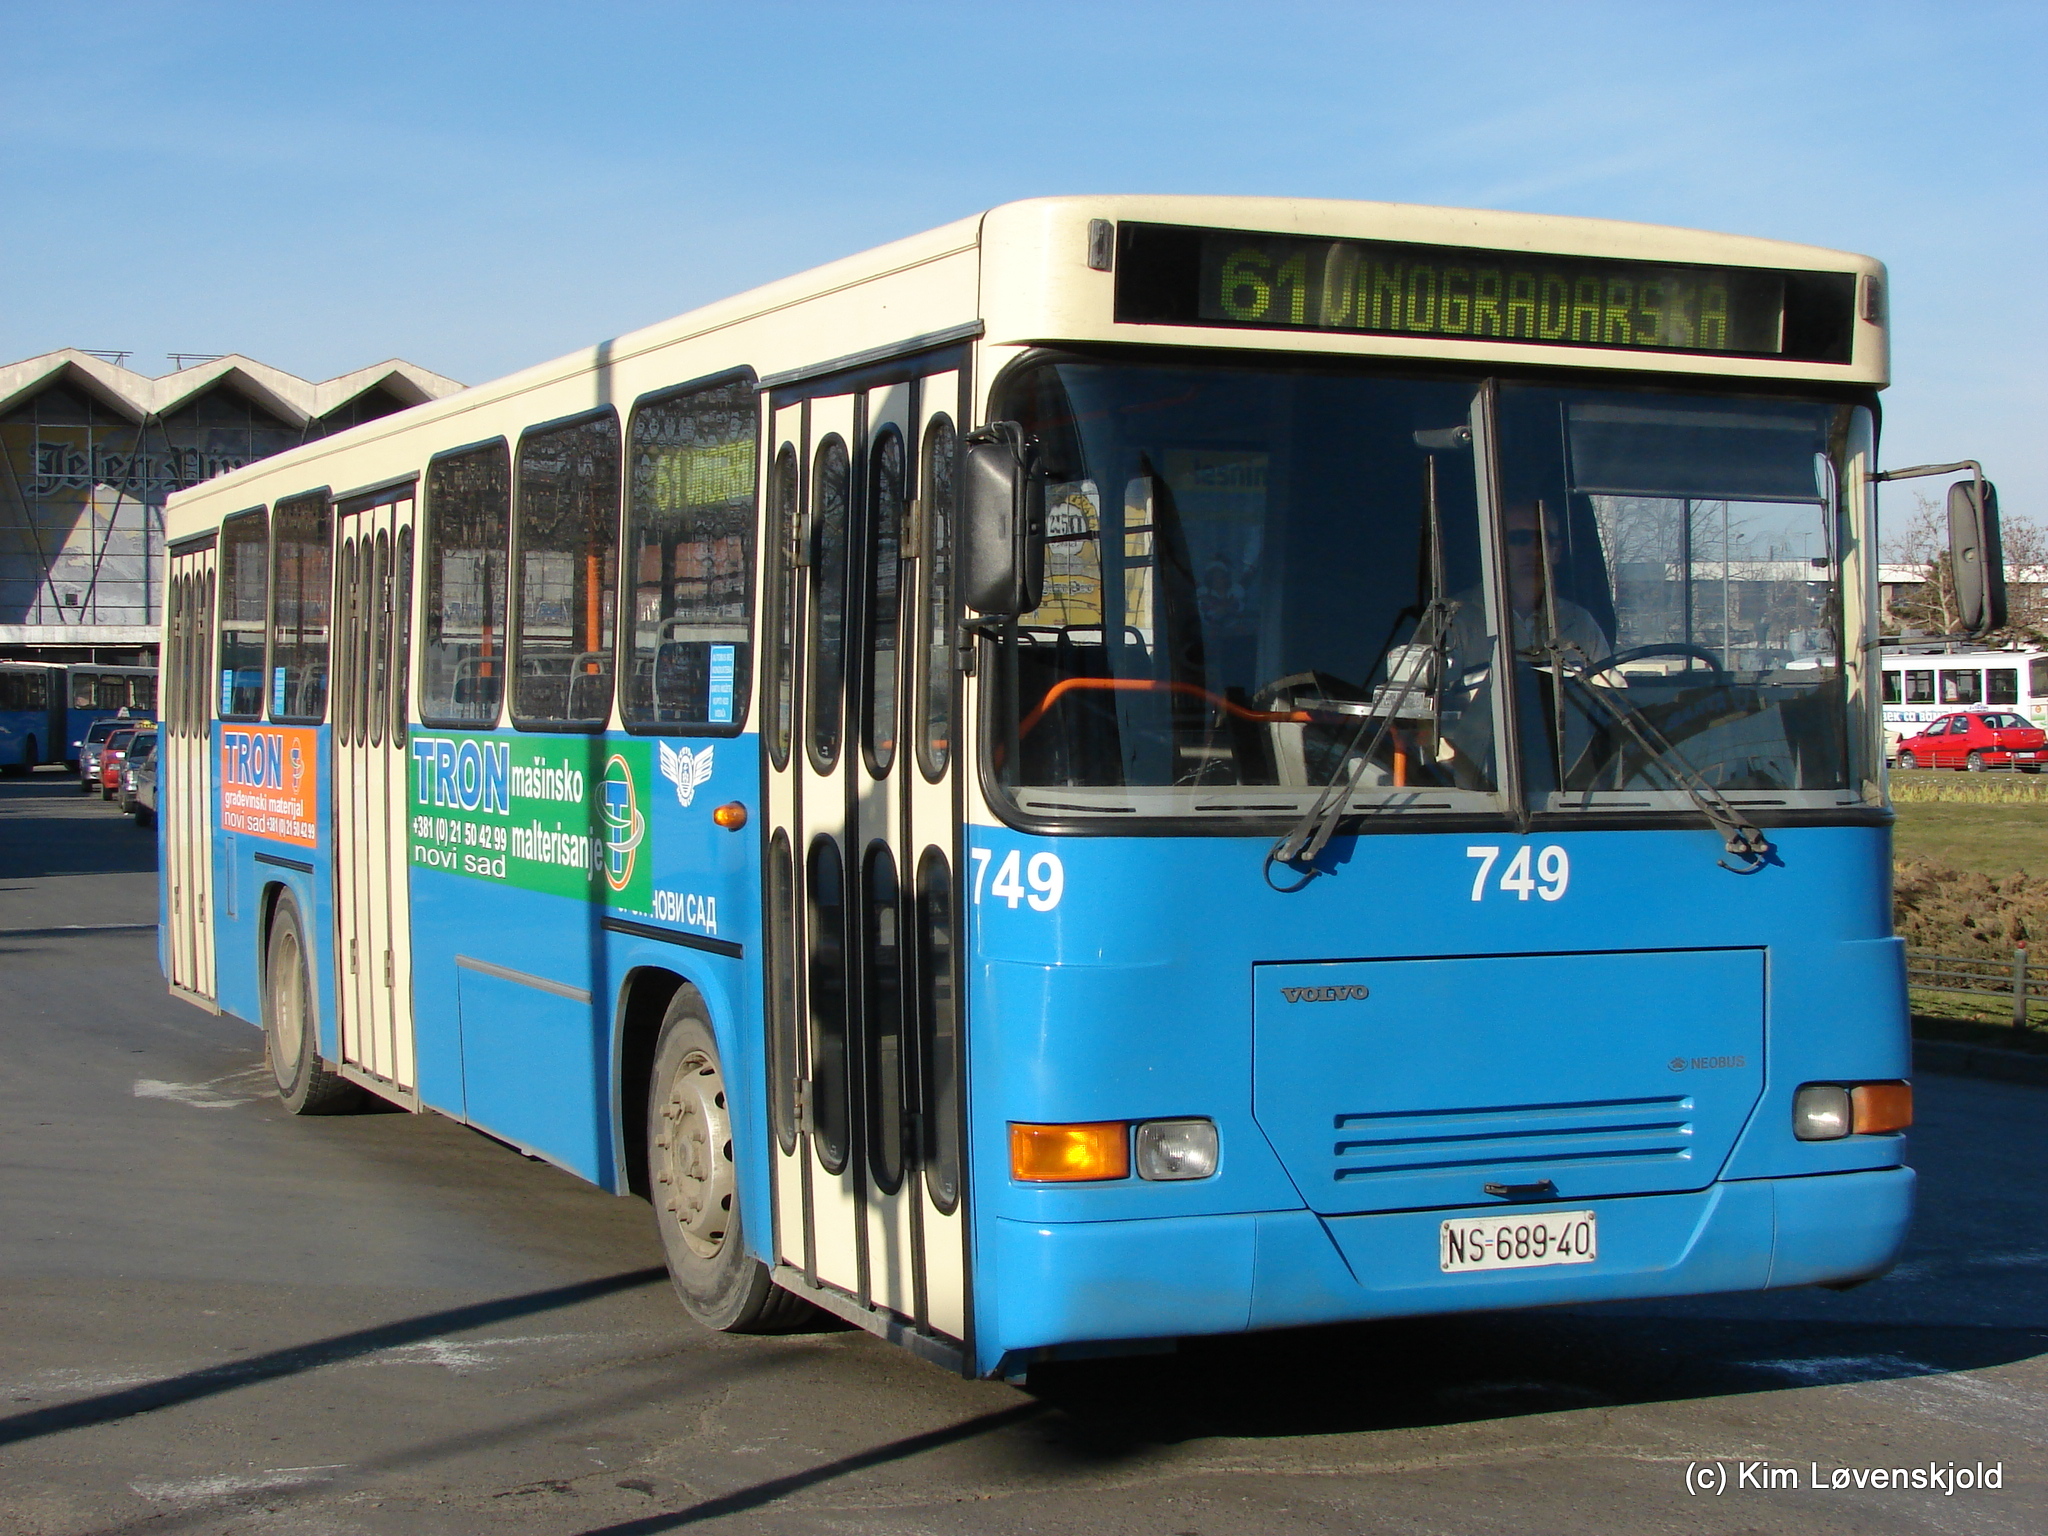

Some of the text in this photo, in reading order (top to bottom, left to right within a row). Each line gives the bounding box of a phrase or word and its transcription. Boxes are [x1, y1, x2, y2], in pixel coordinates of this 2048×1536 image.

[1221, 249, 1728, 349] 61 VINOGRADARSKA
[24, 441, 154, 497] Jelen
[225, 732, 283, 790] TRON
[412, 737, 510, 815] TRON
[511, 756, 584, 803] mašinsko
[224, 810, 245, 829] novi
[247, 813, 266, 833] sad
[268, 797, 304, 821] materijal
[413, 815, 507, 852] +381 (0) 21 50 42 99
[511, 819, 604, 882] malterisanje
[414, 845, 507, 879] novi sad
[971, 846, 1065, 912] 749
[1466, 844, 1569, 902] 749
[686, 893, 718, 936] САД
[1280, 984, 1369, 1004] VOLVO
[1690, 1055, 1746, 1070] NEOBUS
